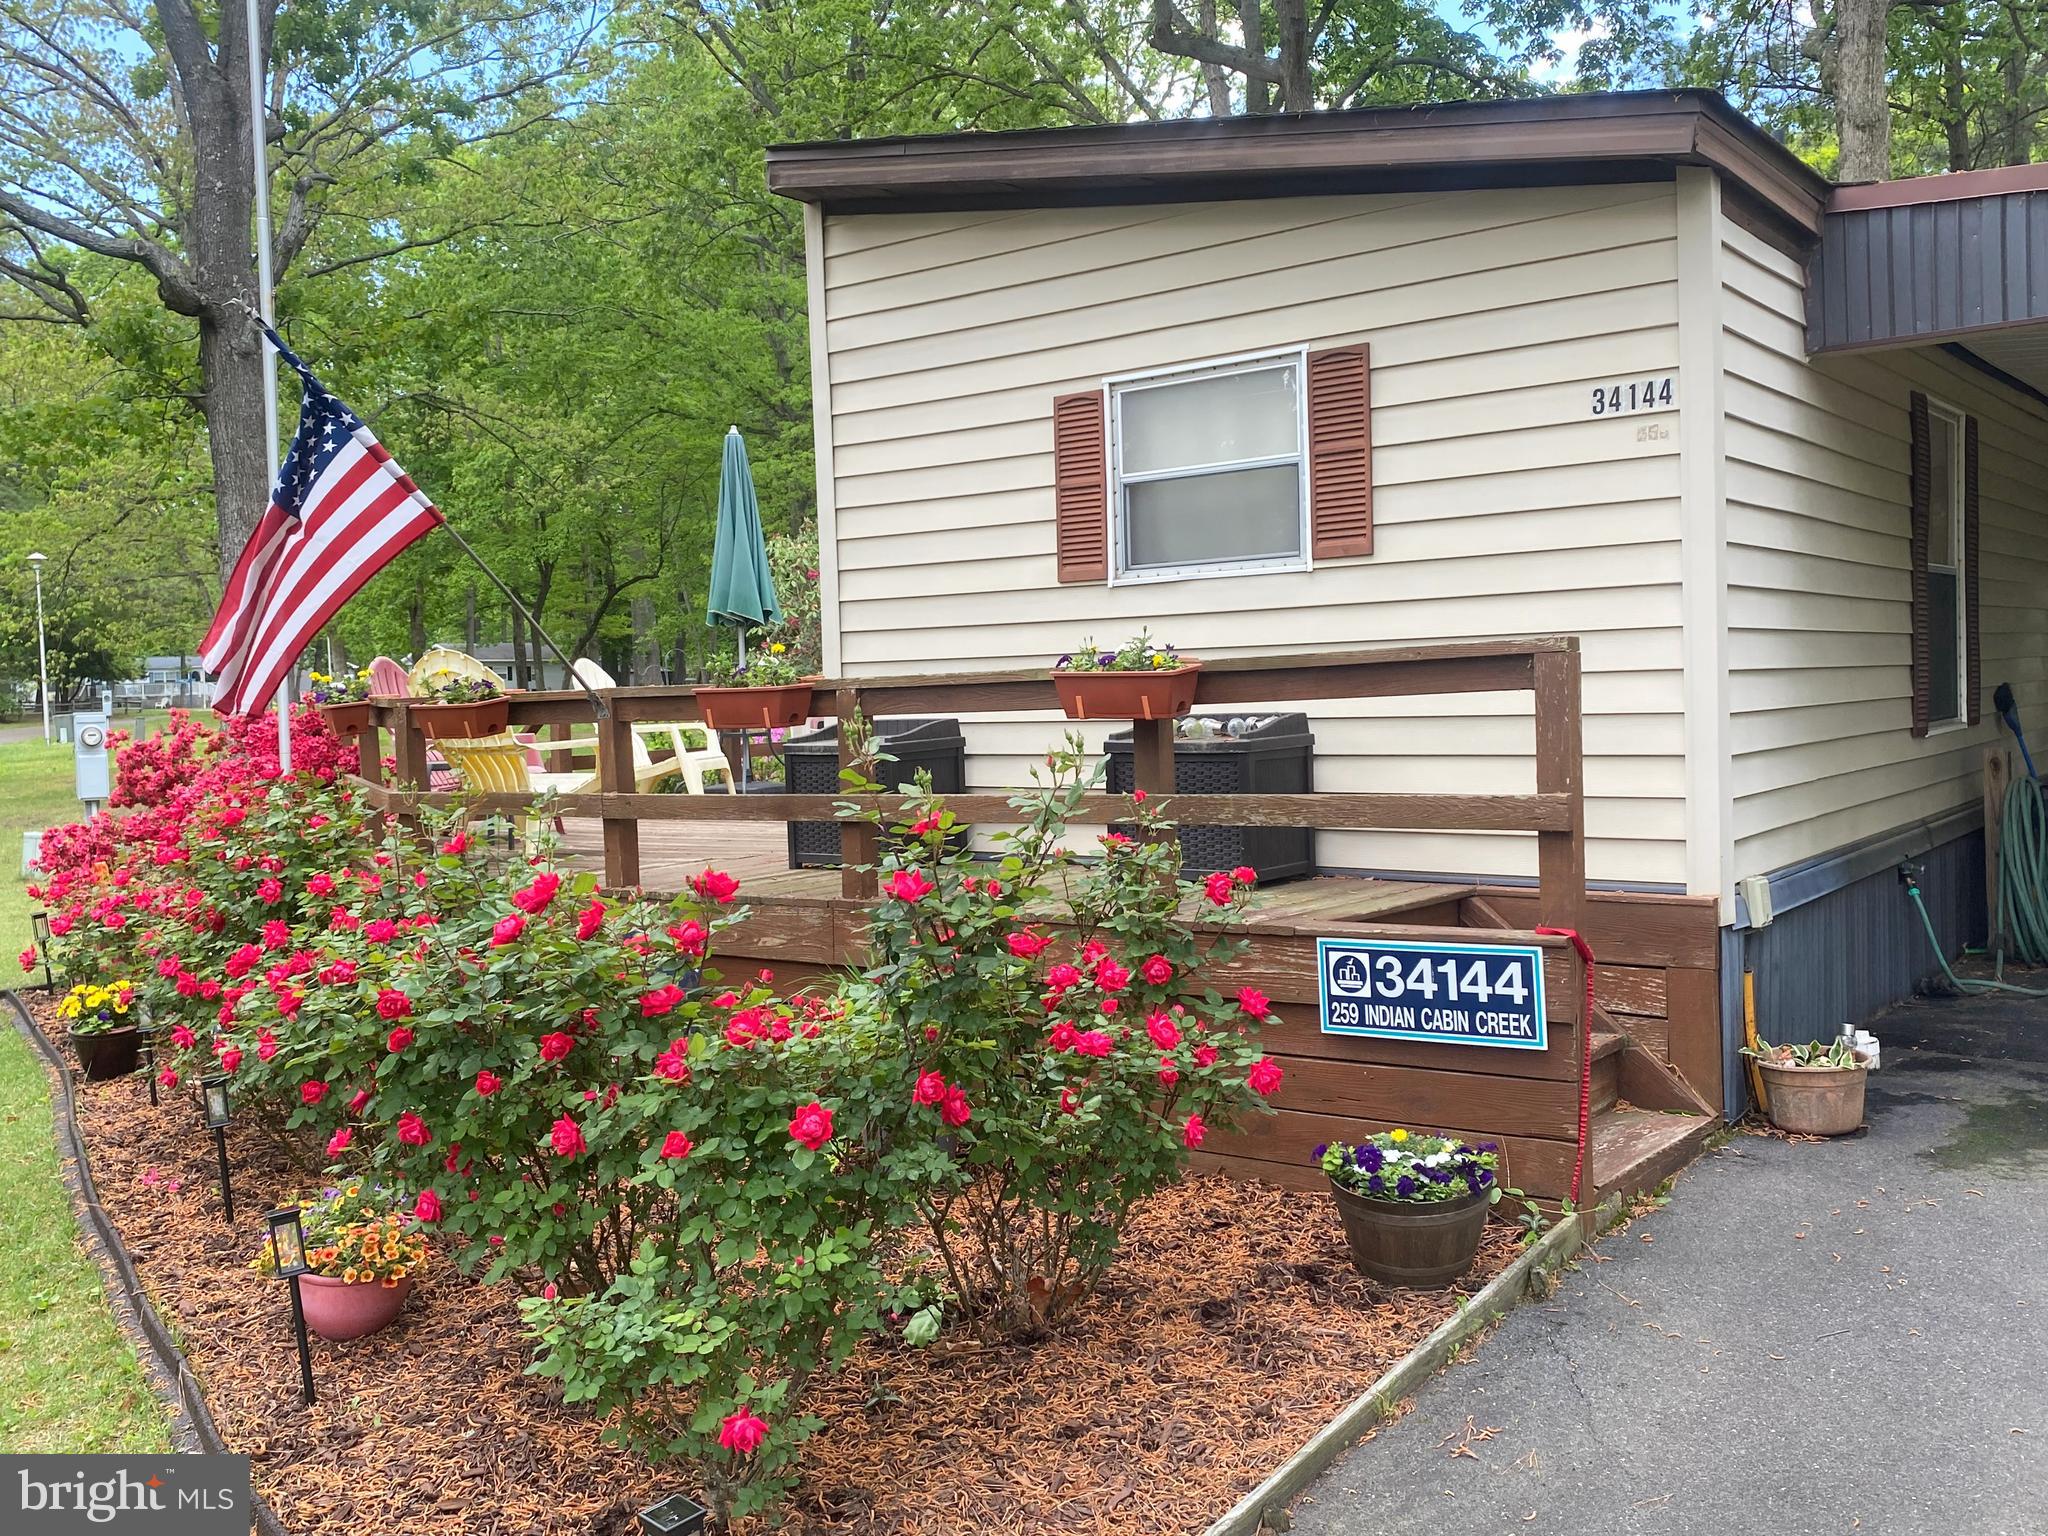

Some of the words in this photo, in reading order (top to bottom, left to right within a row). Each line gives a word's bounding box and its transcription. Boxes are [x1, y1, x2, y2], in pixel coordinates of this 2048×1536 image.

[1592, 378, 1673, 415] 34144
[1375, 955, 1528, 1005] 34144
[1331, 1002, 1359, 1025] 259
[1364, 1004, 1416, 1029] INDIAN
[1420, 1007, 1470, 1033] CABIN
[1475, 1011, 1533, 1037] CREEK
